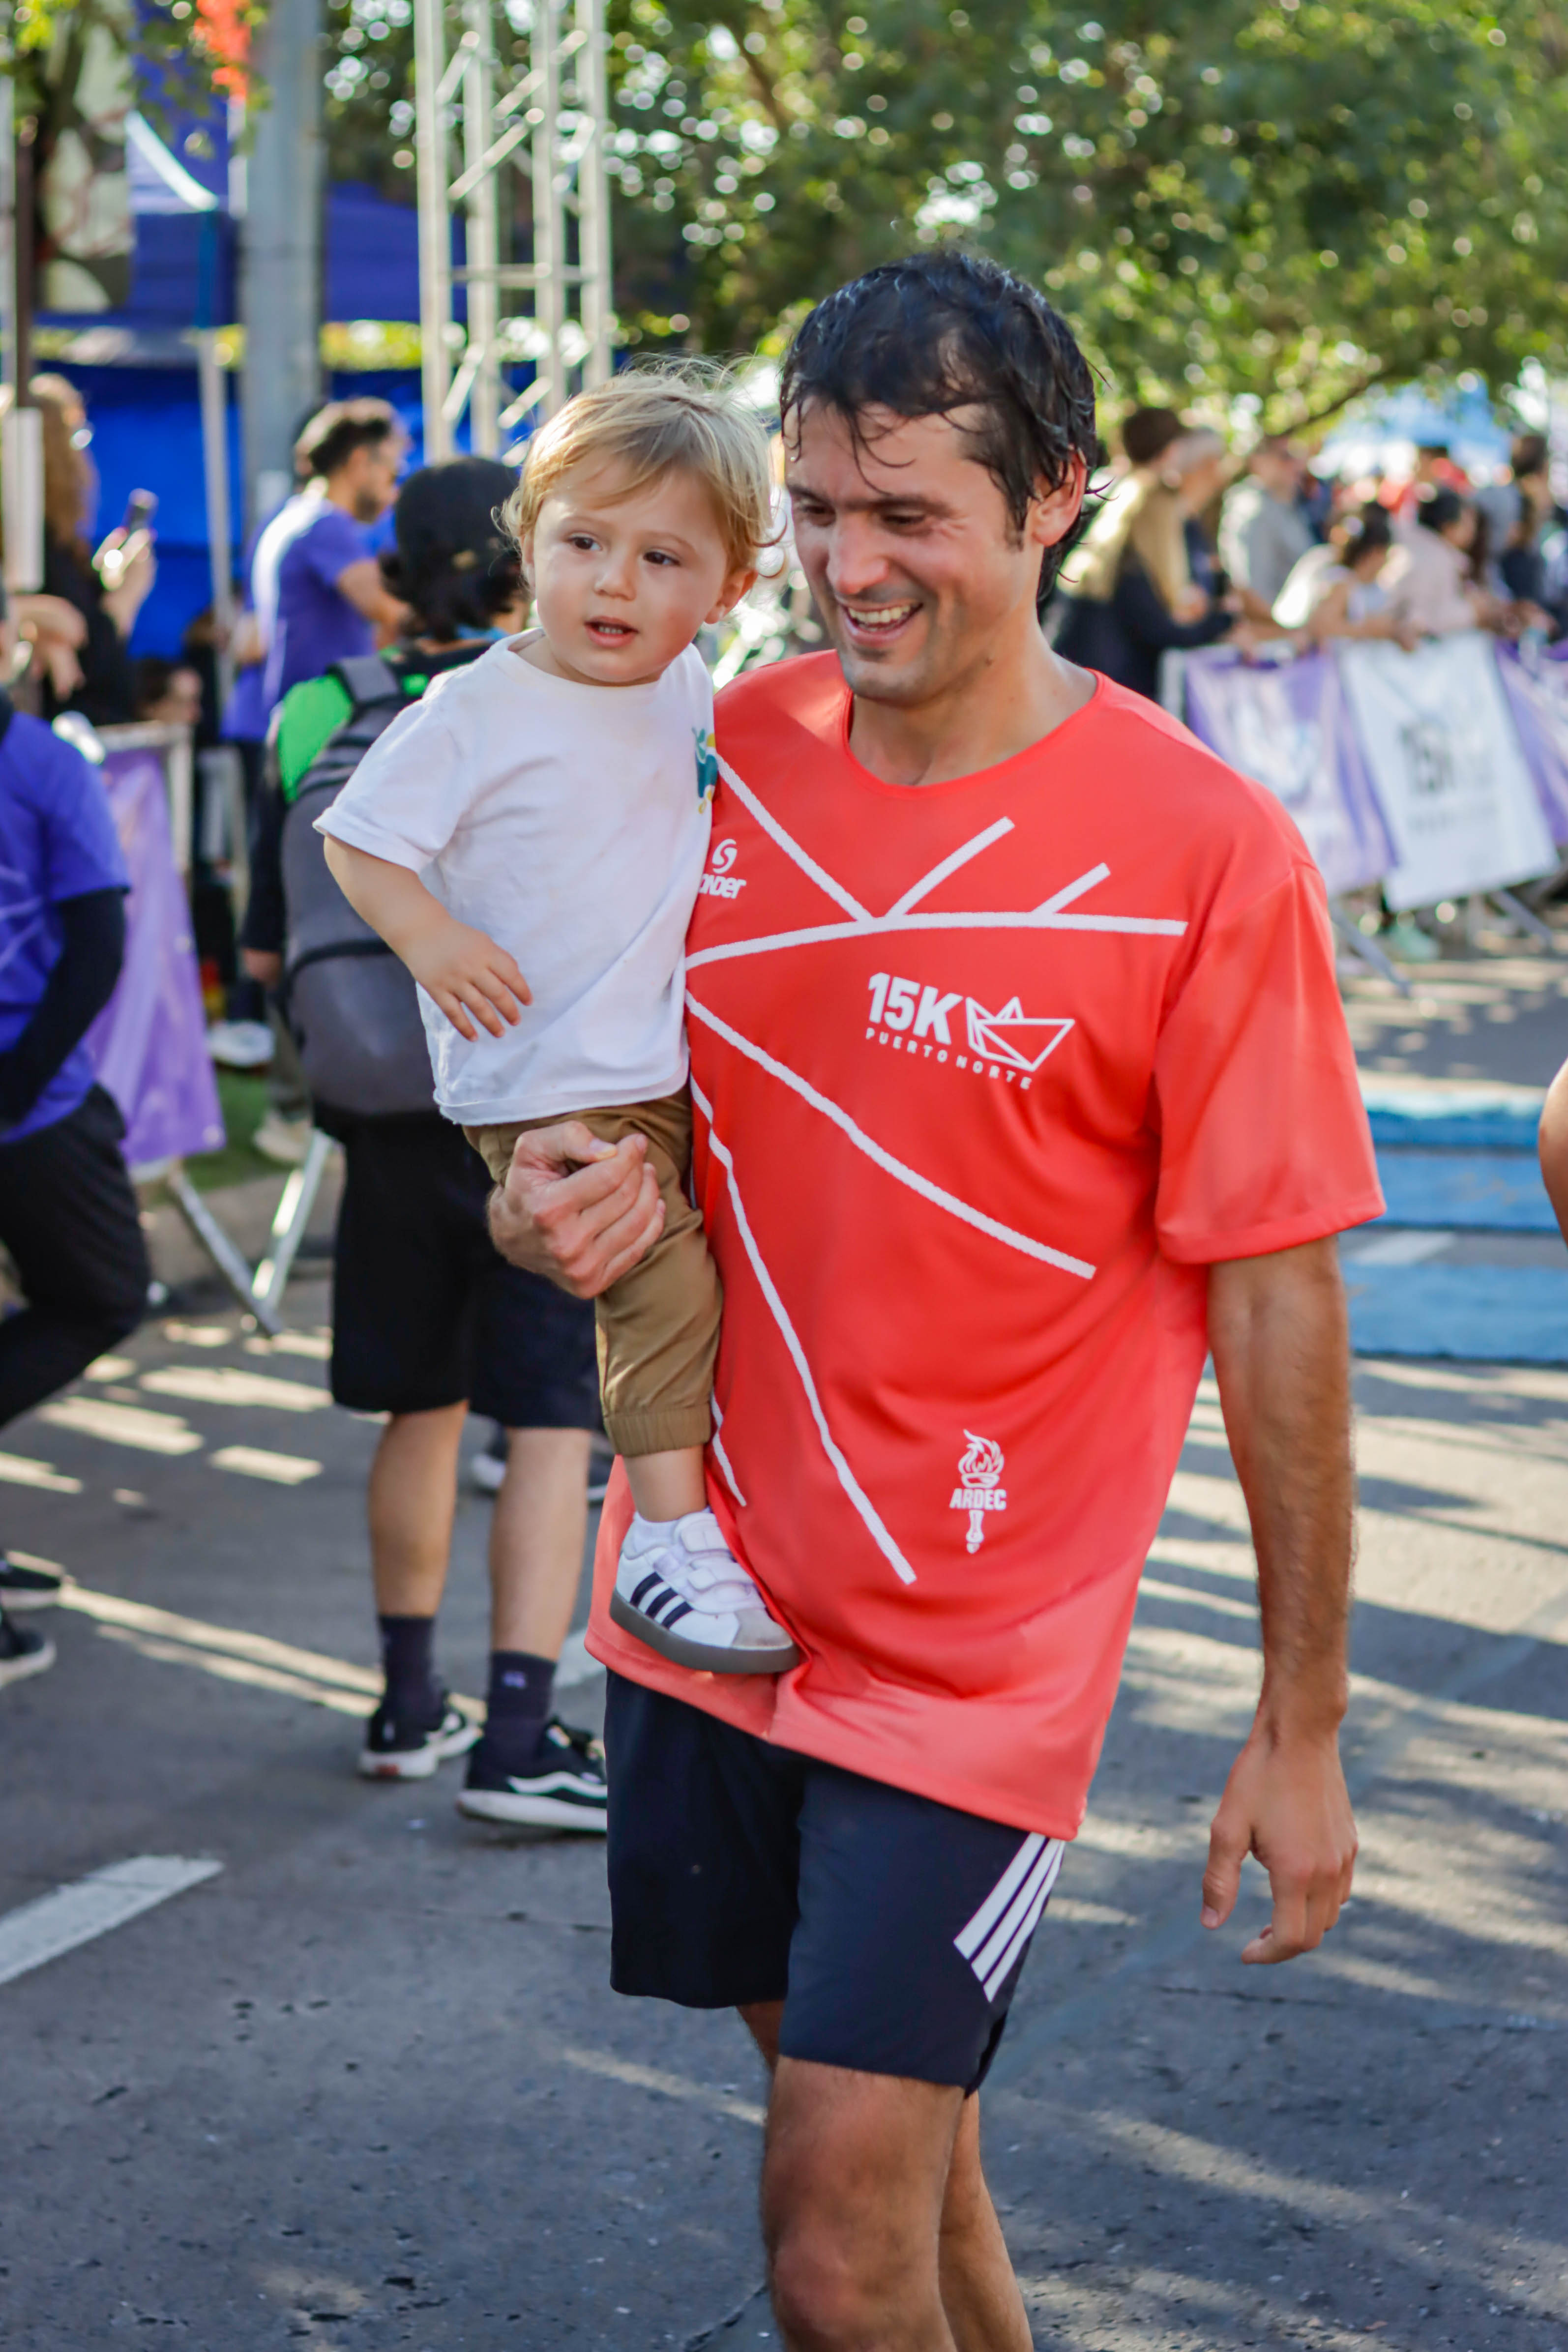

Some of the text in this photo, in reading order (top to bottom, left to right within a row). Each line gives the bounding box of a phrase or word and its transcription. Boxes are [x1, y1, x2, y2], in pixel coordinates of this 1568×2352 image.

[868, 972, 963, 1045] 15K
[865, 1027, 1033, 1090] PUERTO NORTE
[949, 1488, 1006, 1510] ARDEC
